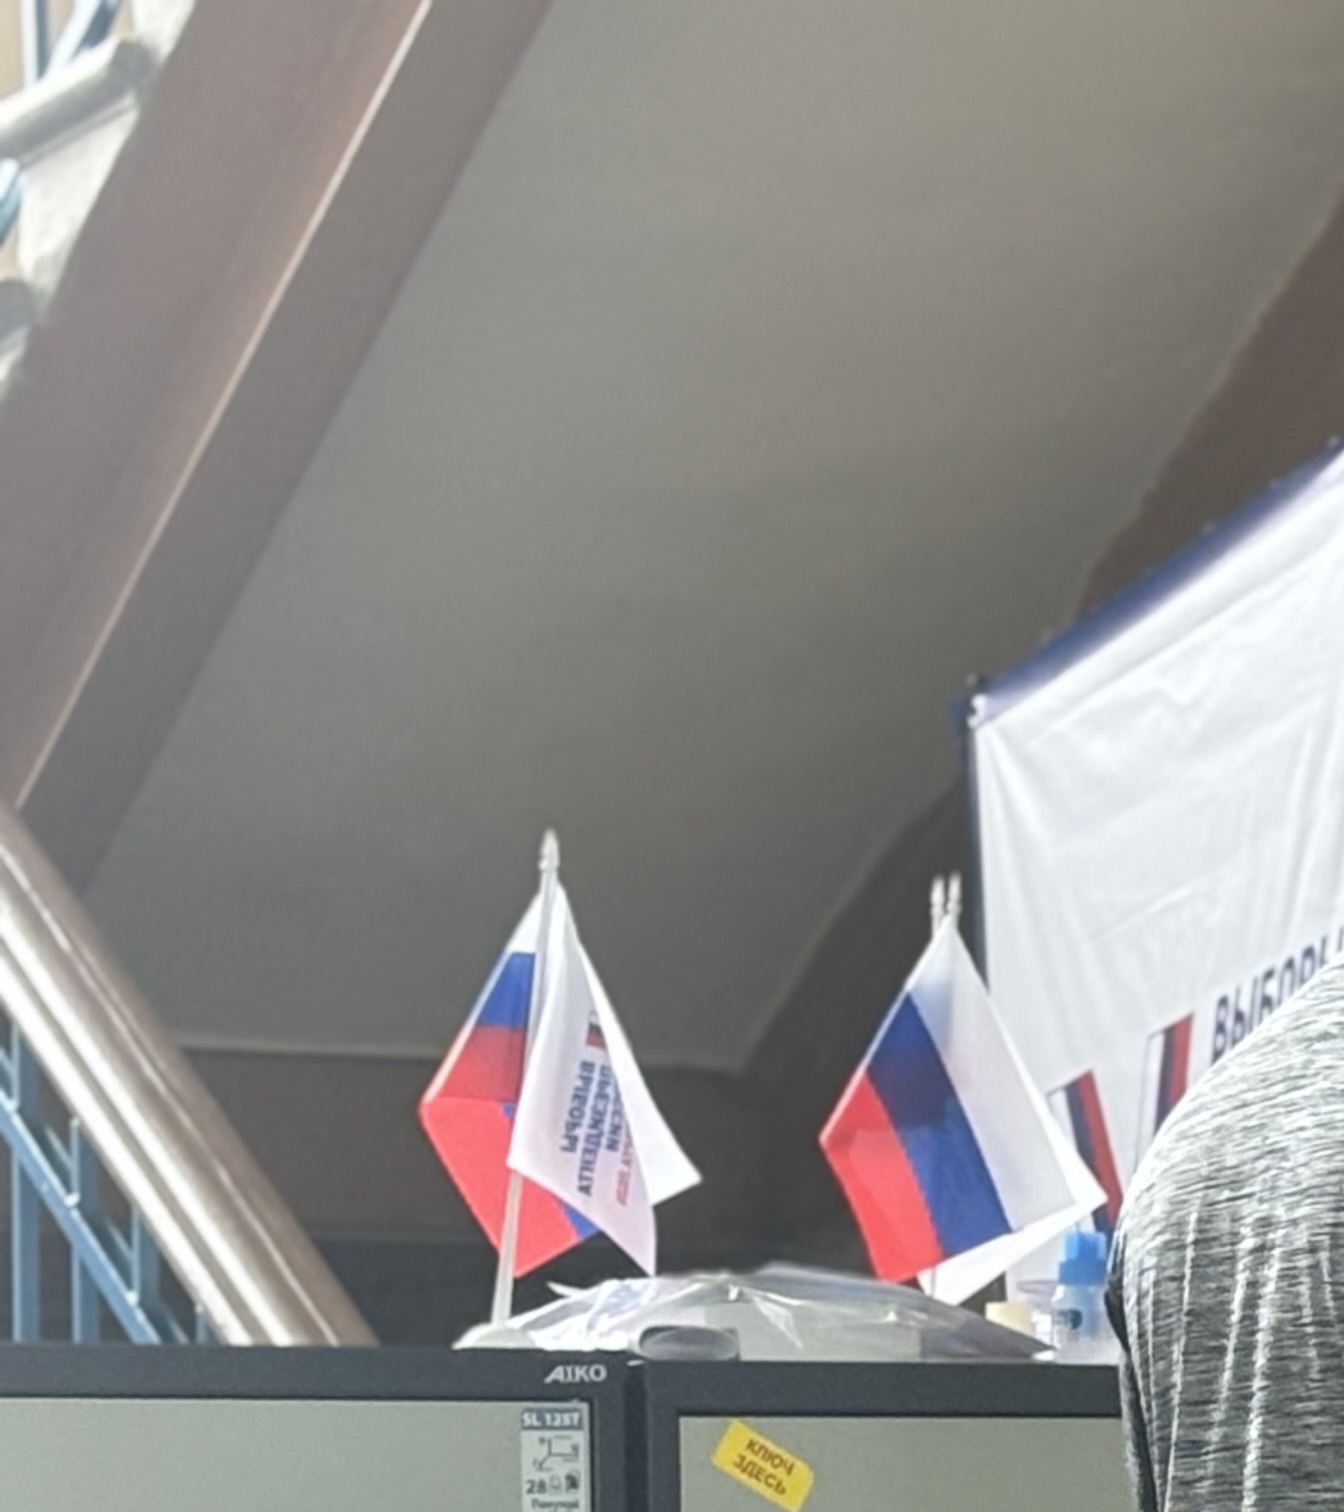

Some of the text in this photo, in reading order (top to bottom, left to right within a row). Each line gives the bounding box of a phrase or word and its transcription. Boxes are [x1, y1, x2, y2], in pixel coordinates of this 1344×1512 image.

[544, 1364, 608, 1385] AIKO
[732, 1456, 787, 1497] ЗДЕСЬ
[745, 1438, 796, 1477] КЛЮЧ
